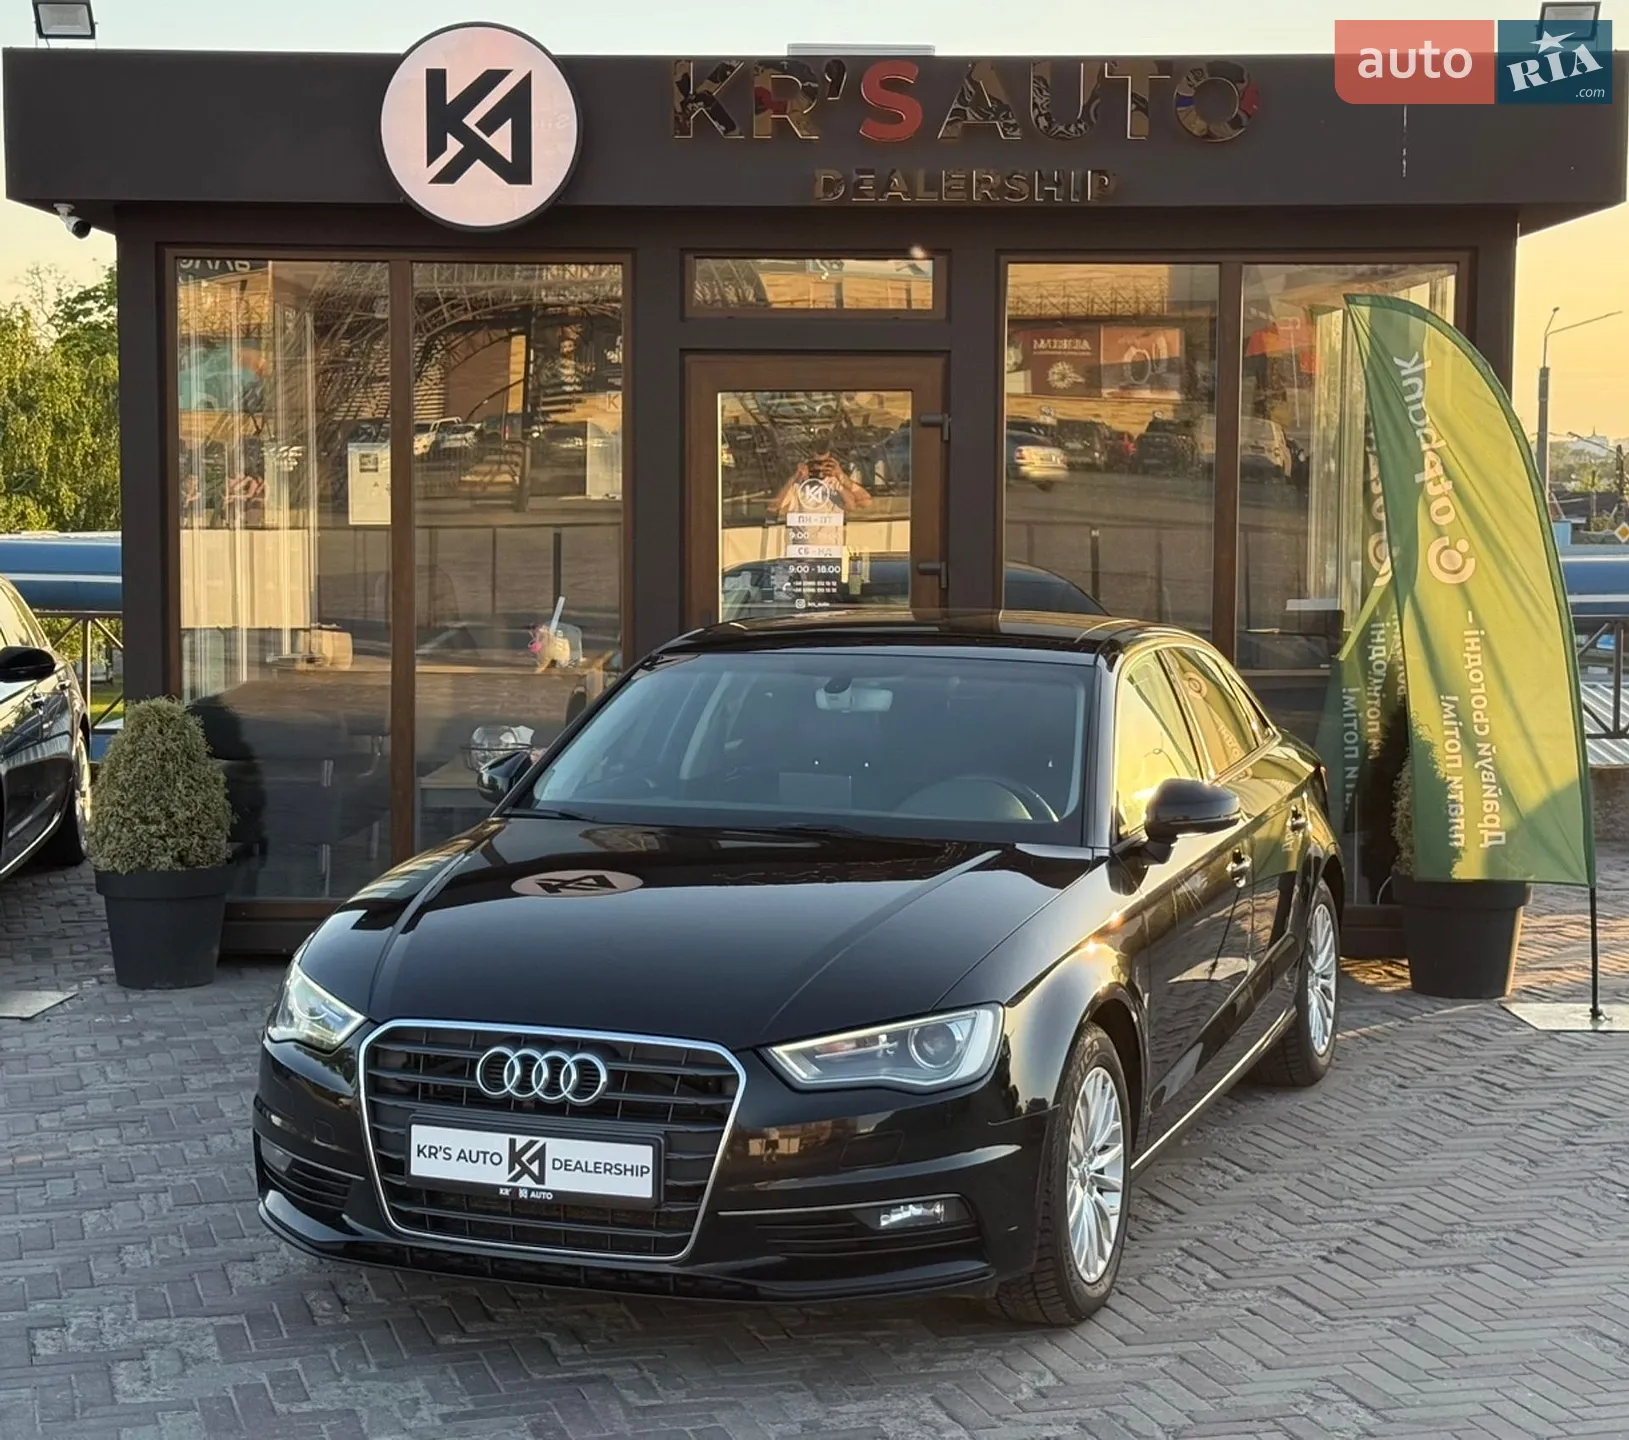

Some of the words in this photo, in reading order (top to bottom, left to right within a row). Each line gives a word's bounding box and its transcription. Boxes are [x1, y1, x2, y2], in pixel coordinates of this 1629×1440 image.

[672, 59, 923, 142] KR'S
[937, 59, 1260, 142] AUTO
[814, 168, 1118, 202] DEALERSHIP
[416, 1143, 452, 1161] KR'S
[456, 1148, 503, 1166] AUTO
[551, 1158, 650, 1178] DEALERSHIP
[530, 1191, 553, 1200] AUTO
